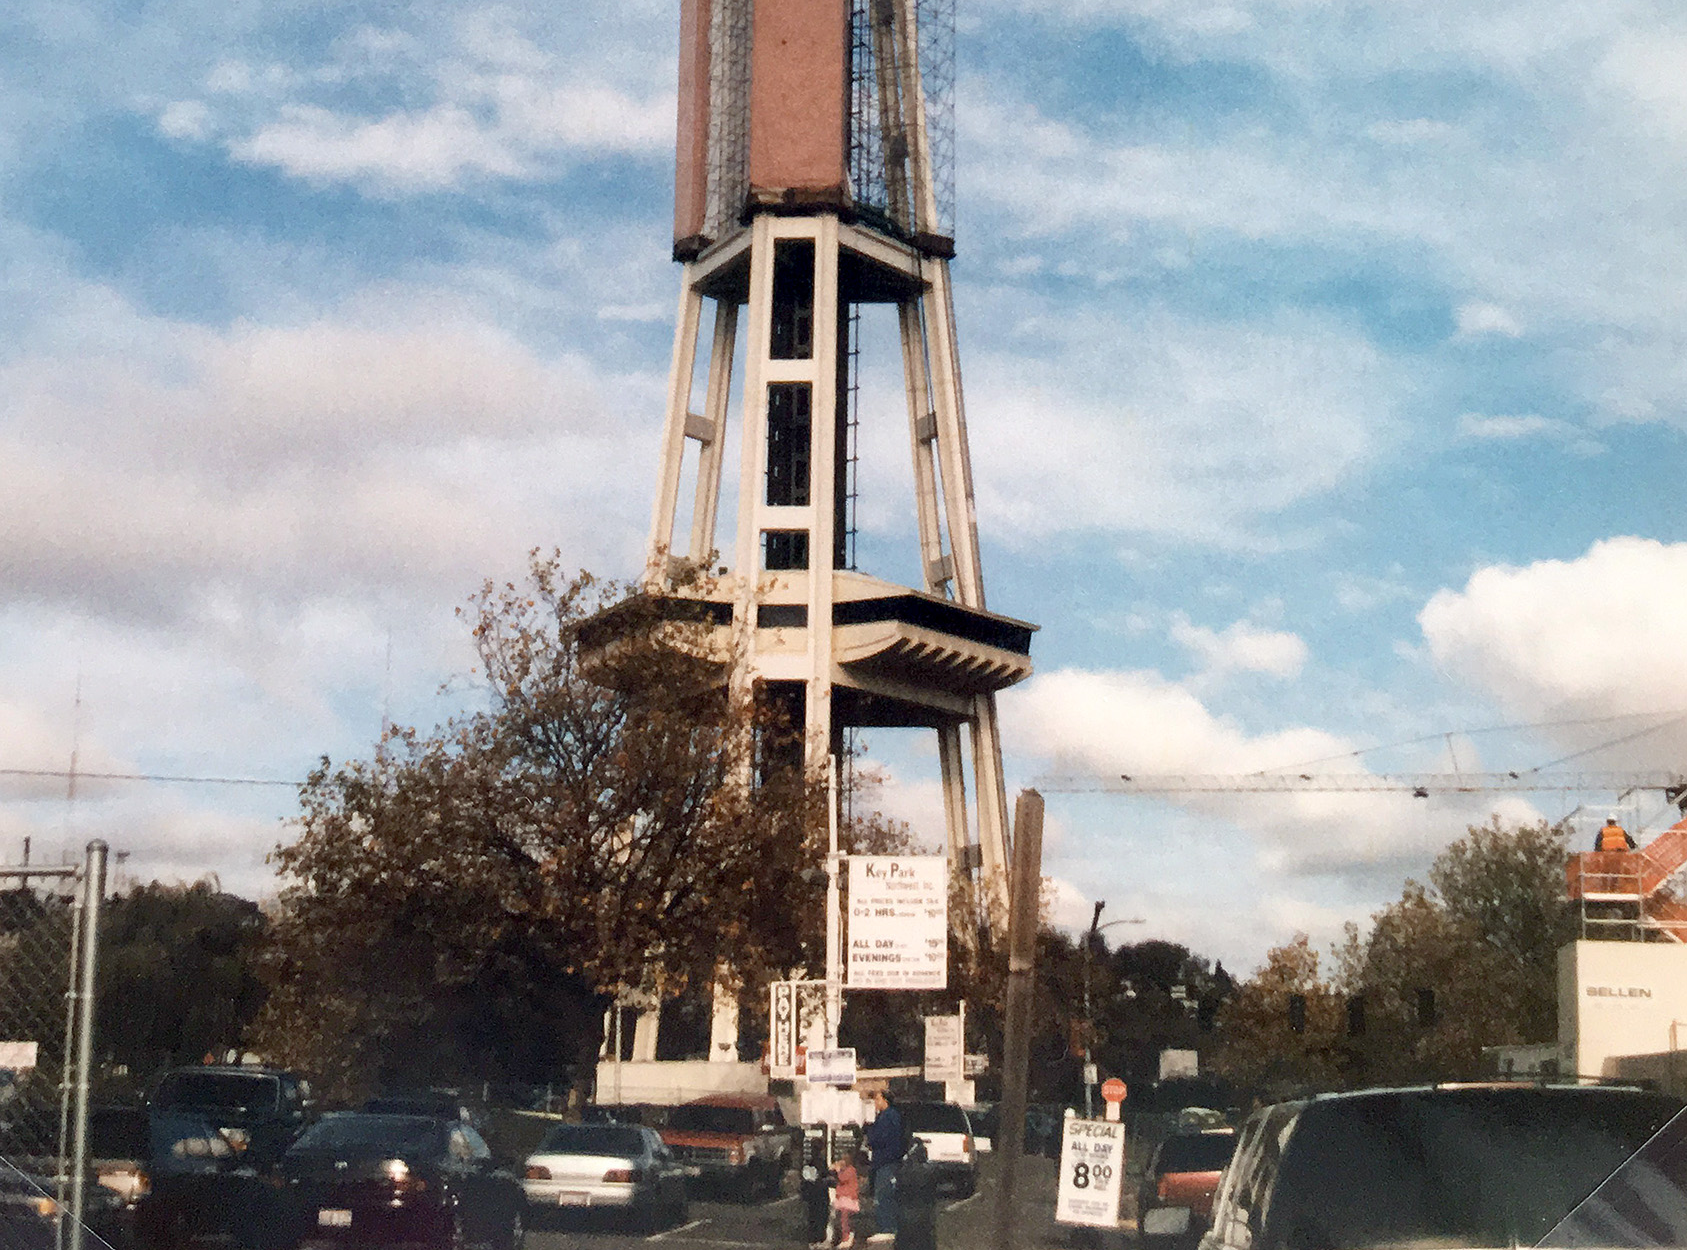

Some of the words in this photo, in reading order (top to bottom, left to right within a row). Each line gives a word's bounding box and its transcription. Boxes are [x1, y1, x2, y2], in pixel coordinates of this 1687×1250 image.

[866, 862, 887, 880] Key
[890, 862, 916, 878] Park
[853, 908, 870, 917] 0-2
[853, 939, 870, 948] ALL
[875, 939, 894, 948] DAY
[852, 953, 901, 962] EVENINGS
[1586, 986, 1652, 998] SELLEN
[1069, 1123, 1118, 1139] SPECIAL
[1071, 1141, 1088, 1152] ALL
[1094, 1143, 1113, 1154] DAY
